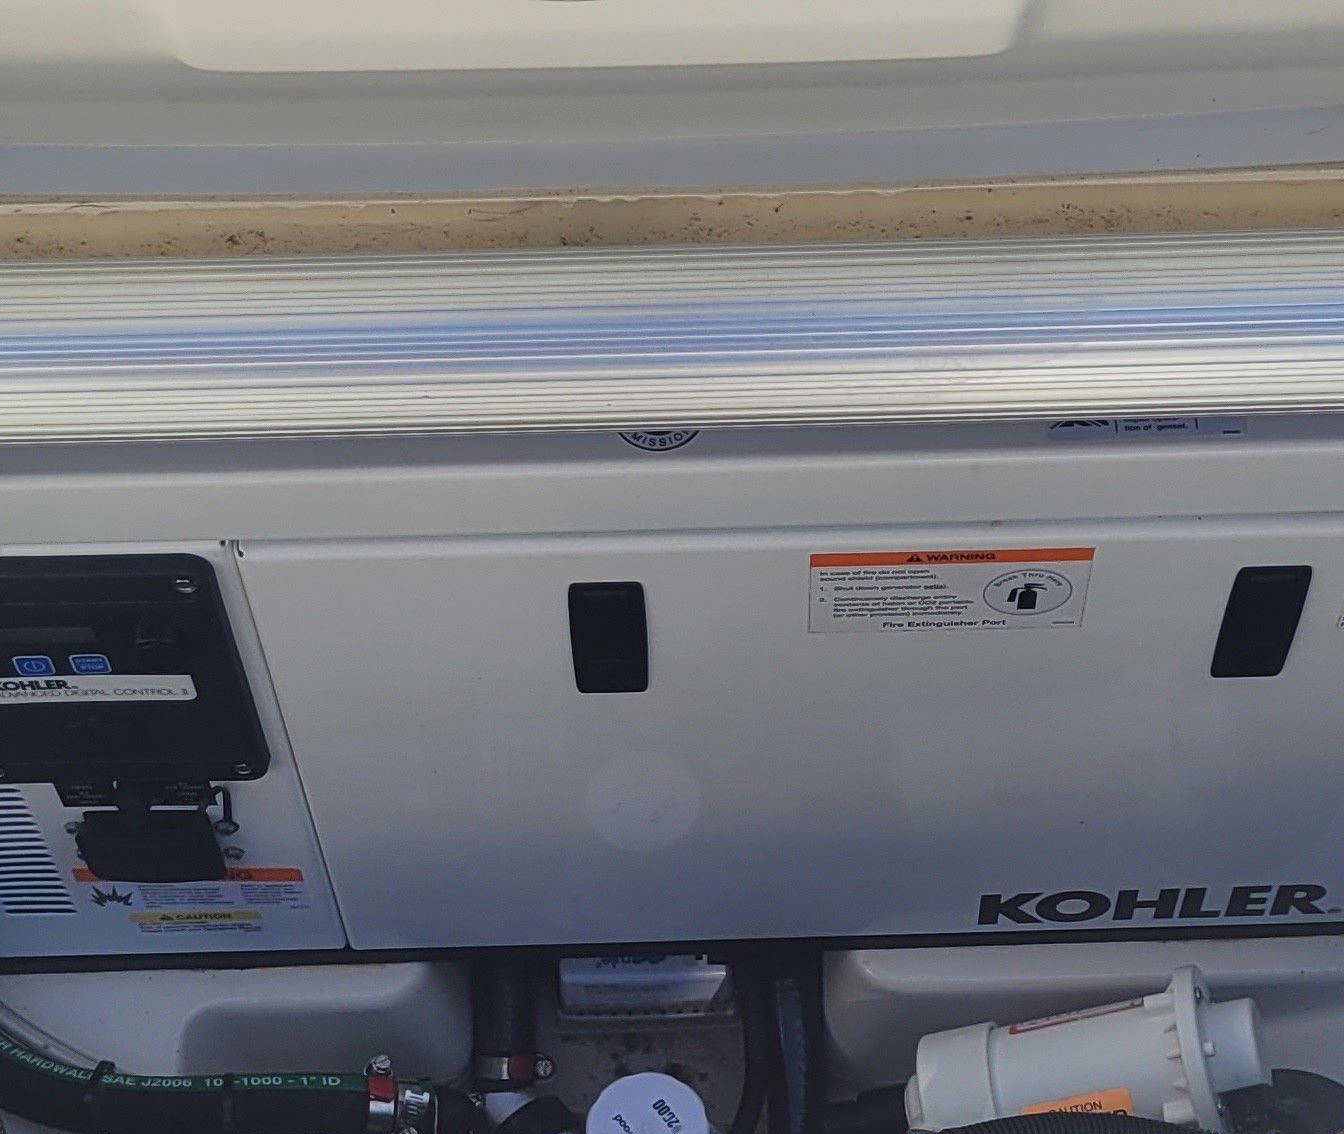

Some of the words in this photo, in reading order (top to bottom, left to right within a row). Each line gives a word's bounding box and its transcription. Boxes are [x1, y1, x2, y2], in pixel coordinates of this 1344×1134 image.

[927, 552, 996, 562] WARNING
[882, 620, 903, 628] Fire
[907, 619, 978, 629] Extinguisher
[982, 618, 1006, 627] Port
[62, 689, 109, 697] DIGITAL
[977, 884, 1327, 925] KOHLER
[176, 911, 231, 921] CAUTION
[141, 1075, 193, 1088] J2006
